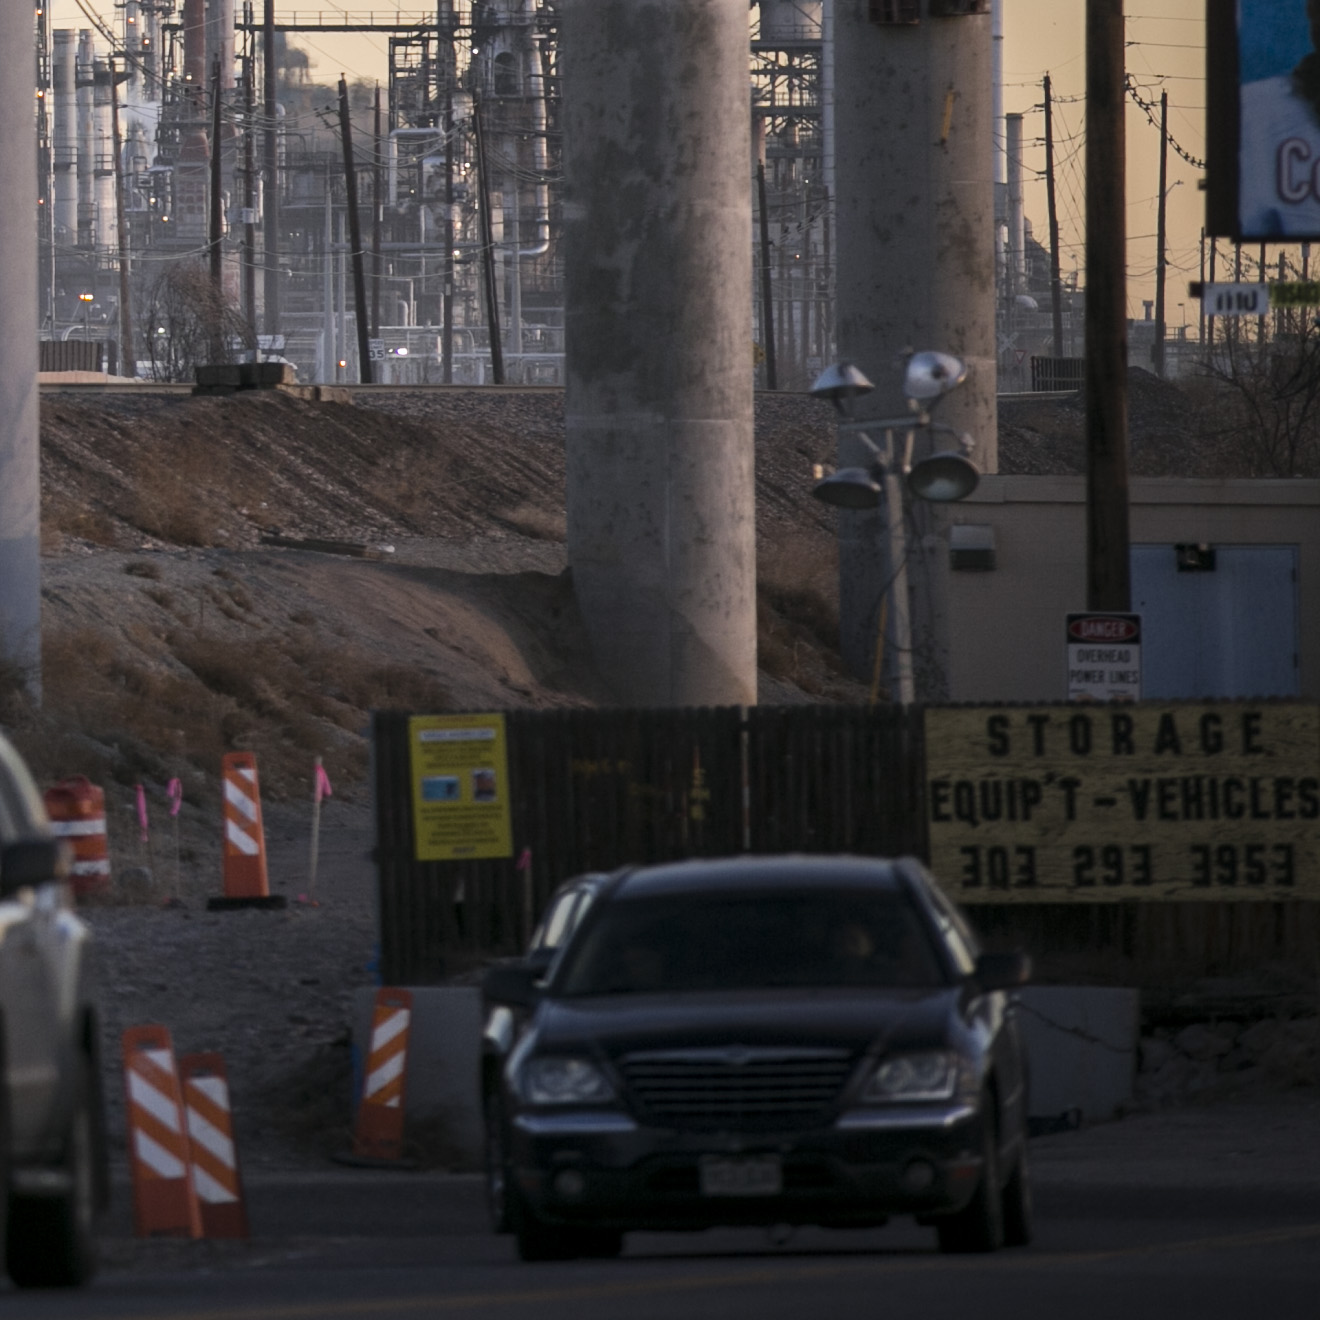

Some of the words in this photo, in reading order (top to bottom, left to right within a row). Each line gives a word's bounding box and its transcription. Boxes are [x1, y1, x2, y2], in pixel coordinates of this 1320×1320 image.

[1080, 620, 1126, 637] DANGER
[1077, 648, 1131, 663] OVERHEAD
[1070, 669, 1104, 684] POWER
[1110, 670, 1138, 684] LINES
[987, 711, 1263, 757] STORAGE
[960, 845, 1037, 889] 303
[1072, 844, 1152, 887] 293
[1190, 843, 1295, 887] 3953
